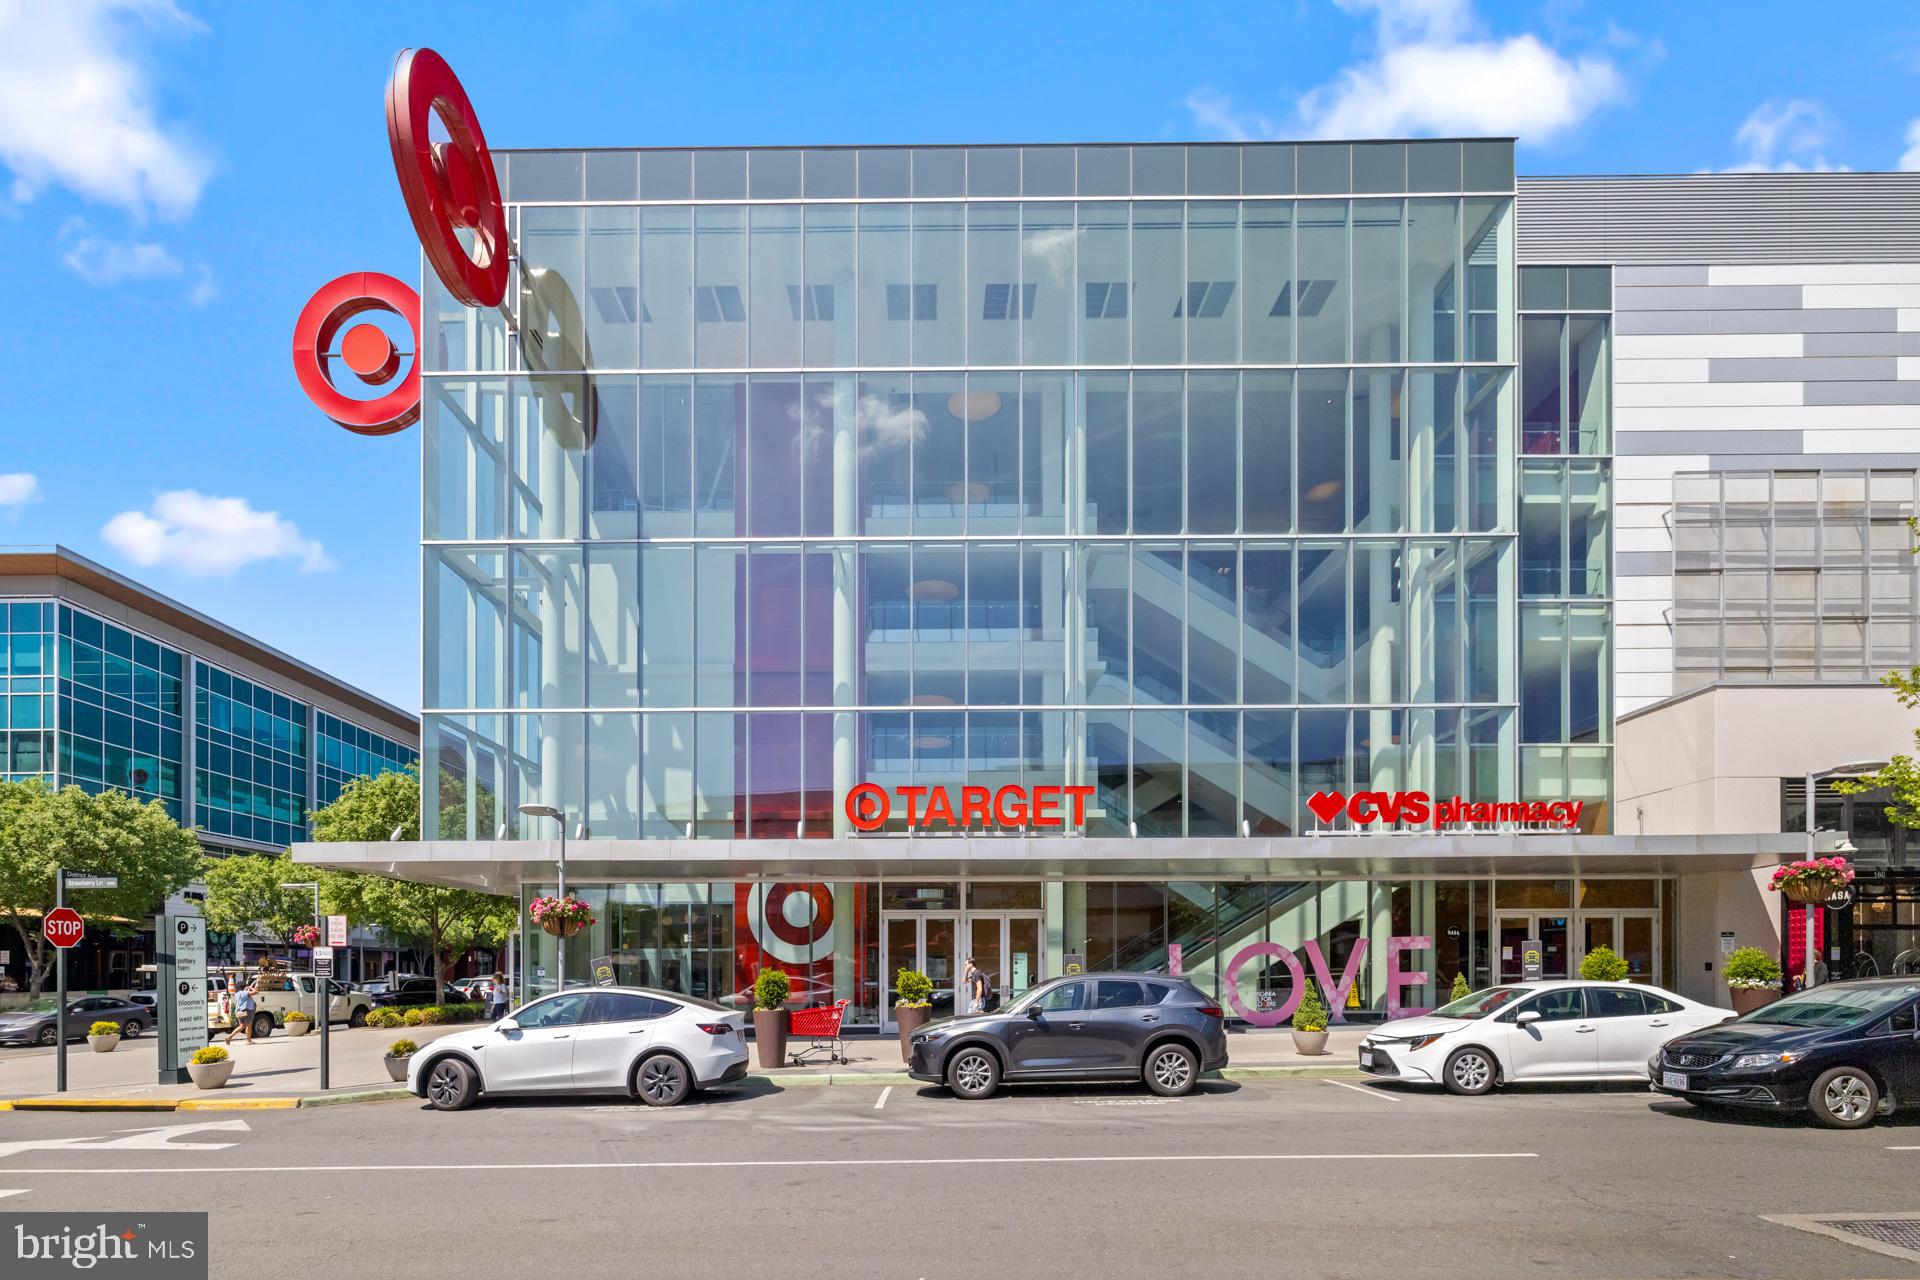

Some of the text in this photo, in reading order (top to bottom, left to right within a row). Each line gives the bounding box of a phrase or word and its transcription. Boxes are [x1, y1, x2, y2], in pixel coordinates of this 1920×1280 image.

[896, 785, 1095, 827] TARGET
[1346, 790, 1584, 830] CVS pharmacy
[1874, 871, 1886, 879] 160
[47, 920, 81, 936] STOP
